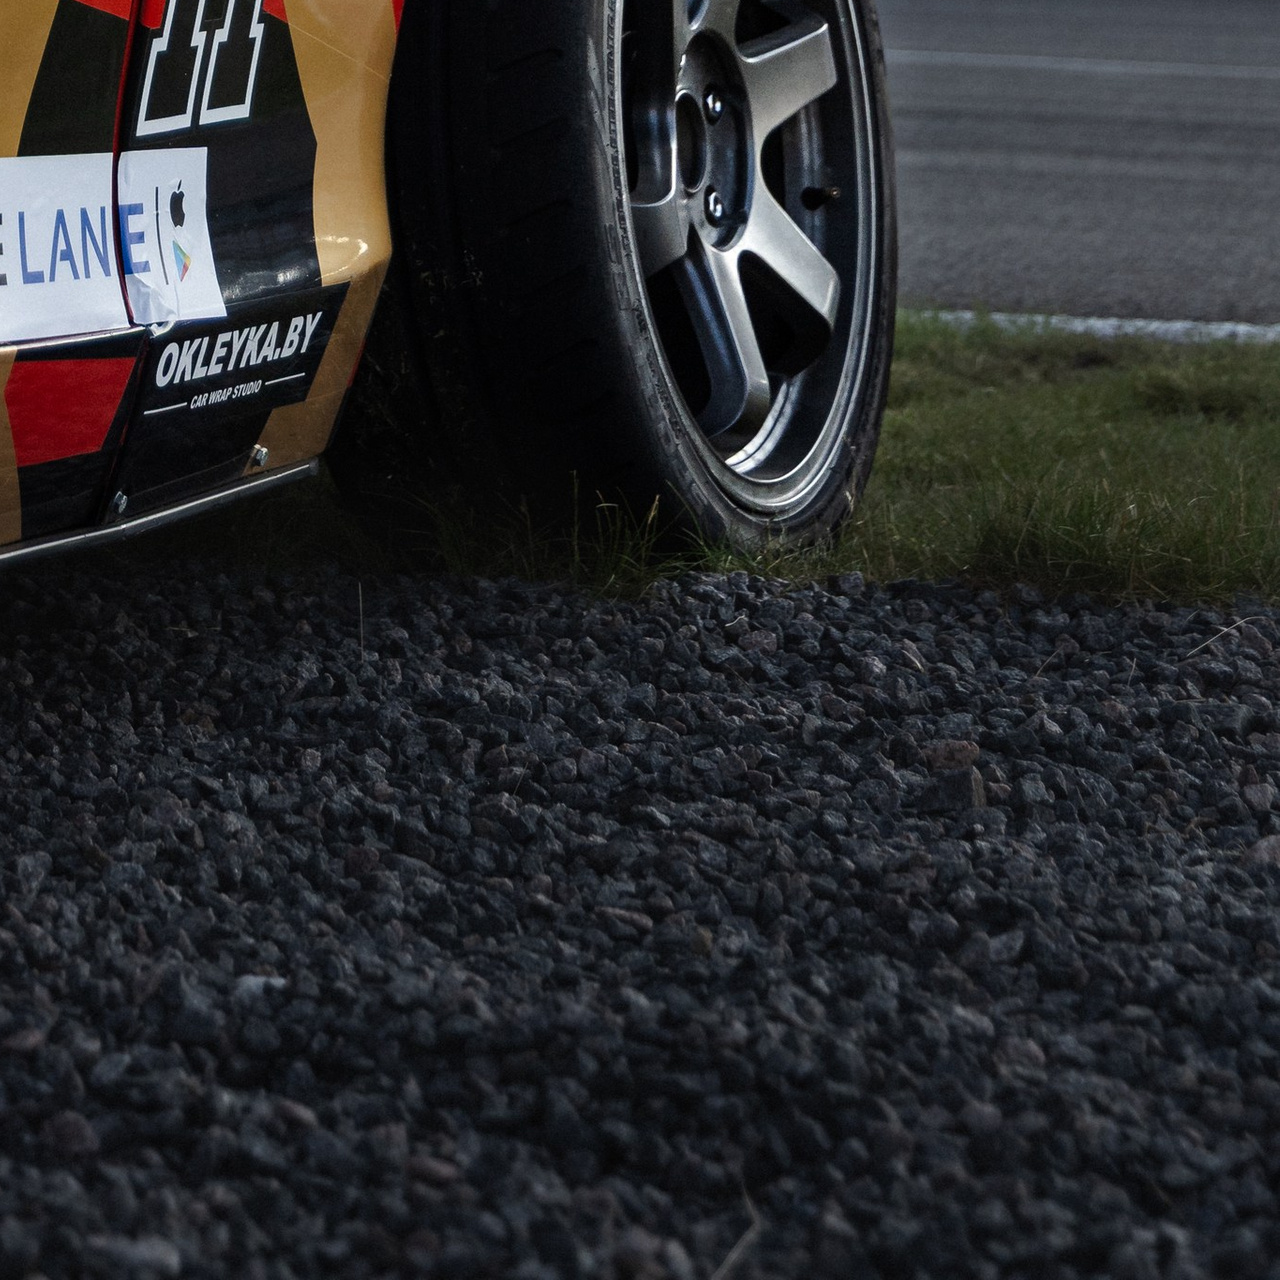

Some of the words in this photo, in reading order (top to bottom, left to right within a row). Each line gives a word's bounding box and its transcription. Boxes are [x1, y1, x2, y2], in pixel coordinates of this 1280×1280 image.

[19, 202, 152, 285] LANE
[155, 311, 323, 388] OKLEYKA.BY
[190, 393, 207, 409] CAR
[209, 388, 233, 404] WRAP
[233, 380, 262, 398] STUDIO
